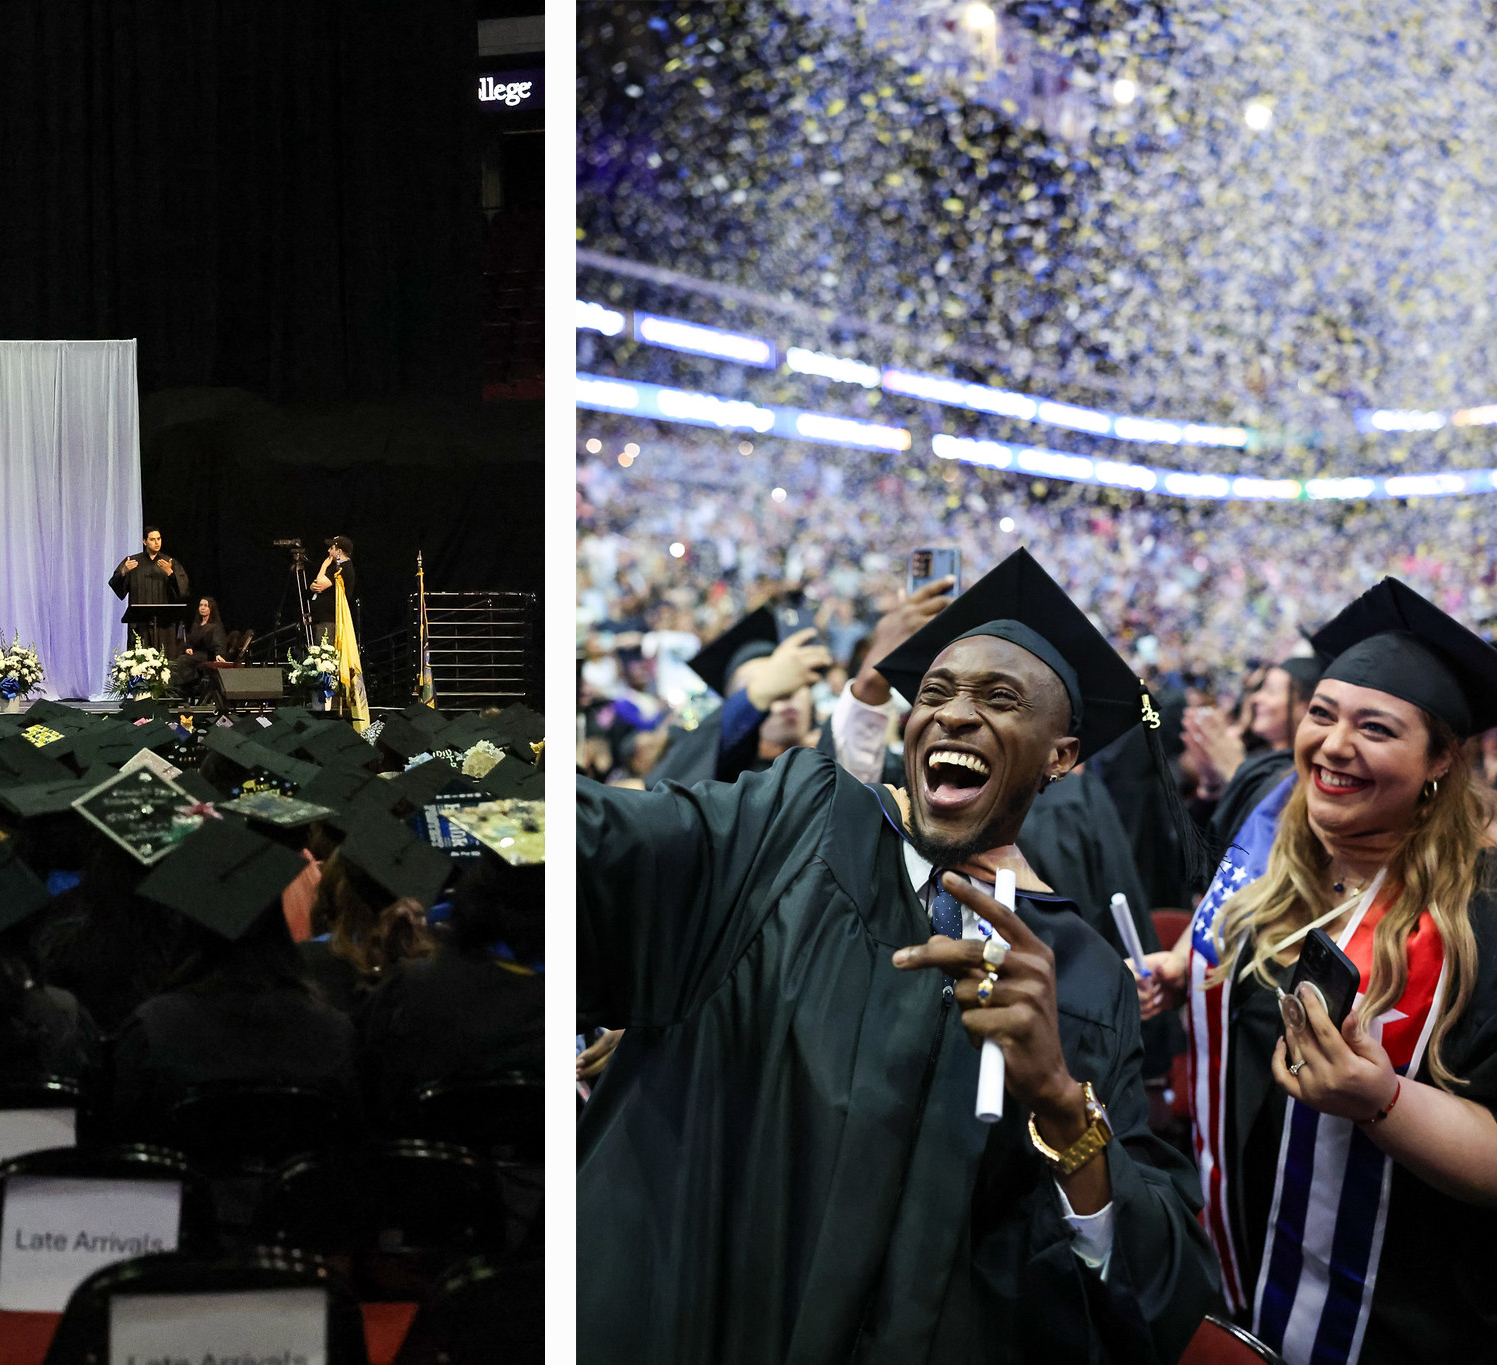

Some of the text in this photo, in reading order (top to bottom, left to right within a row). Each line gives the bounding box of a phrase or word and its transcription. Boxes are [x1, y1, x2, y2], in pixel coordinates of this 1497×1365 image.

[478, 77, 532, 106] llege
[15, 1228, 164, 1255] Late Arrivals
